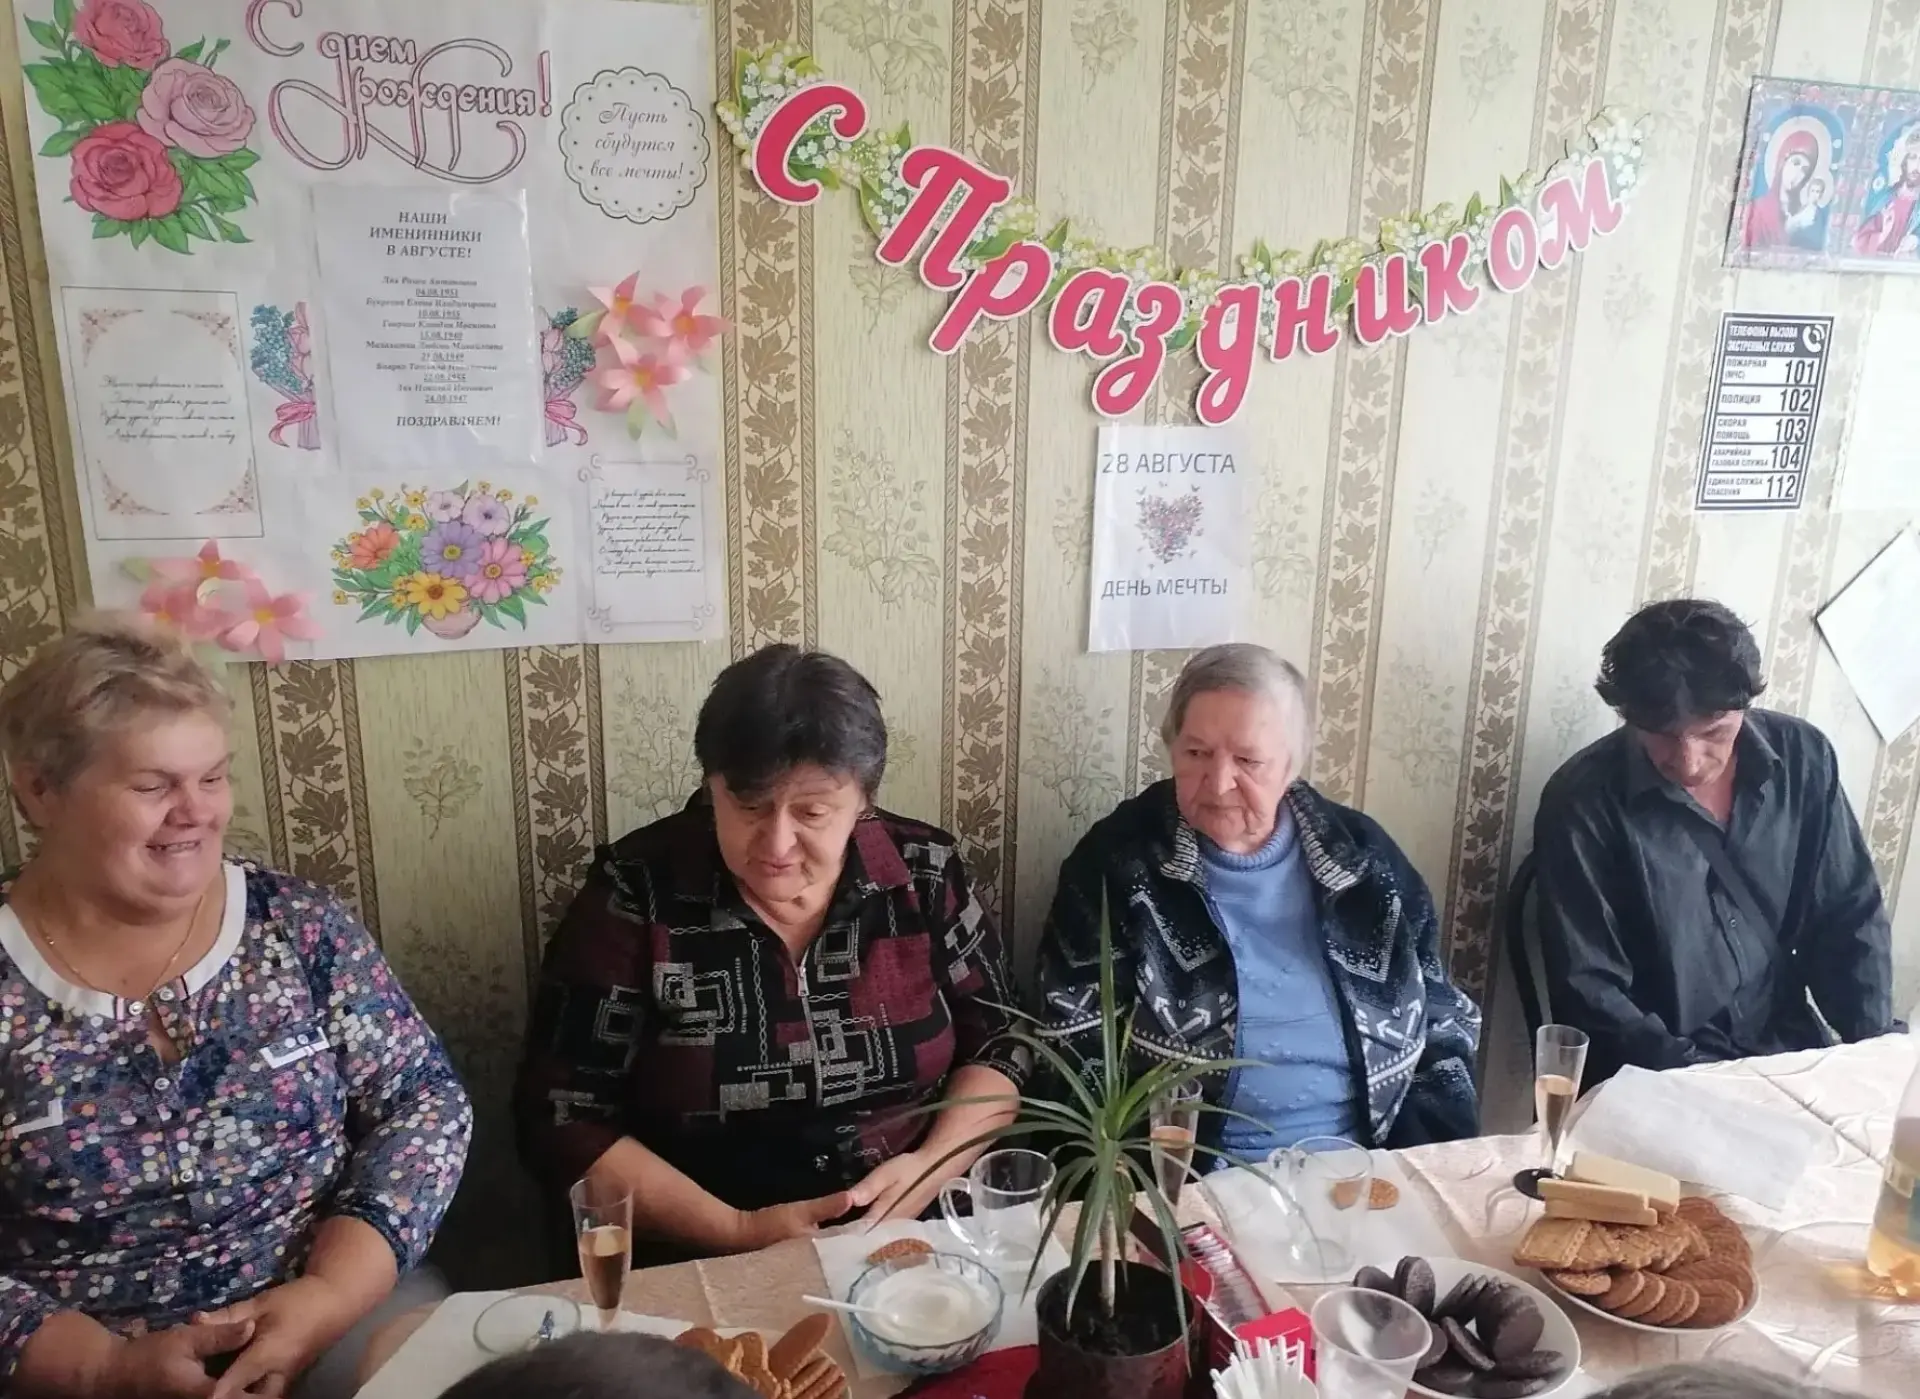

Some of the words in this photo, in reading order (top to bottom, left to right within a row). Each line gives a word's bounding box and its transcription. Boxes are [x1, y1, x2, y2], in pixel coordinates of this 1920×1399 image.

[246, 0, 305, 57] С
[598, 102, 668, 129] Пусть
[594, 132, 676, 157] сбудутся
[750, 81, 867, 206] С
[619, 162, 684, 180] мечты!
[398, 211, 448, 225] НАШИ
[369, 226, 483, 243] ИМЕНИННИКИ
[386, 244, 397, 257] В
[399, 245, 472, 259] АВГУСТЕ!
[1726, 358, 1768, 368] ПОЖАРНАЯ
[1785, 360, 1815, 384] 101
[1721, 394, 1762, 404] ПОЛИЦИЯ
[1780, 388, 1813, 412] 102
[396, 416, 501, 428] ПОЗДРАВЛЯЕМ!
[1717, 418, 1747, 428] СКОРАЯ
[1775, 418, 1806, 442] 103
[1715, 431, 1751, 440] ПОМОЩЬ
[1102, 453, 1129, 473] 28
[1135, 453, 1236, 474] АВГУСТА
[1711, 459, 1740, 467] ГАЗОВАЯ
[1741, 459, 1769, 467] СЛУЖБА
[1713, 448, 1752, 457] АВАРИЙНАЯ
[1771, 446, 1801, 469] 104
[1766, 475, 1797, 498] 112
[1100, 579, 1151, 600] ДЕНЬ
[1156, 578, 1228, 595] МЕЧТЫ
